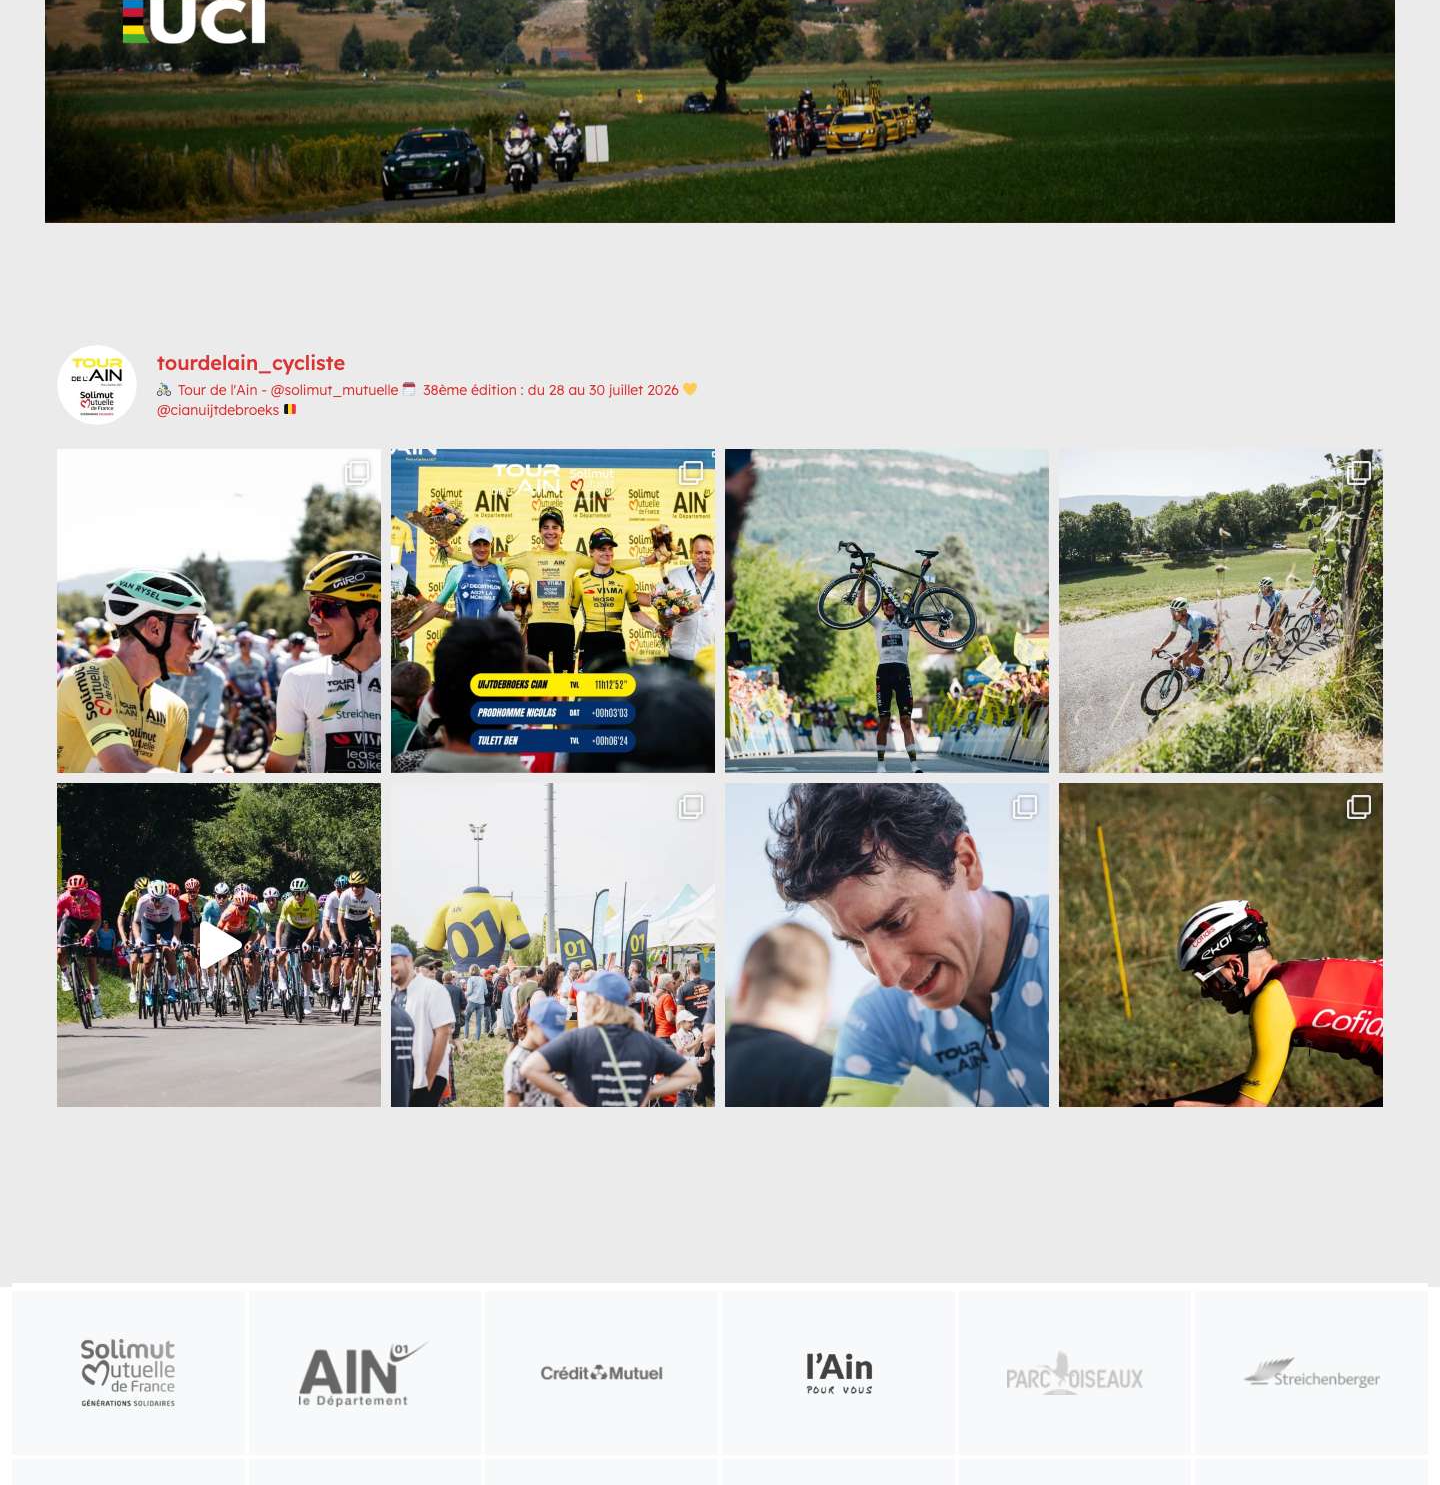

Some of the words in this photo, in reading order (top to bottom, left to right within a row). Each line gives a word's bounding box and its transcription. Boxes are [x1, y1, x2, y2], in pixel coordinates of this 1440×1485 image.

[151, 0, 265, 43] UCI
[157, 354, 345, 375] tourdelain_cycliste
[157, 404, 279, 418] @cianuijtdebroeks
[628, 489, 660, 500] Solimut
[673, 491, 707, 513] AIN
[118, 579, 134, 593] VAN
[133, 583, 160, 601] RYSEL
[446, 909, 504, 959] 01
[1191, 926, 1216, 948] Cofidis
[563, 939, 587, 955] 01
[81, 1339, 174, 1361] Solimut
[297, 1347, 398, 1395] AIN
[540, 1365, 590, 1381] Crédit
[609, 1366, 663, 1381] Mutuel
[1006, 1368, 1051, 1390] PARC
[1068, 1368, 1143, 1390] OISEAUX
[1273, 1370, 1380, 1388] Streichenberger
